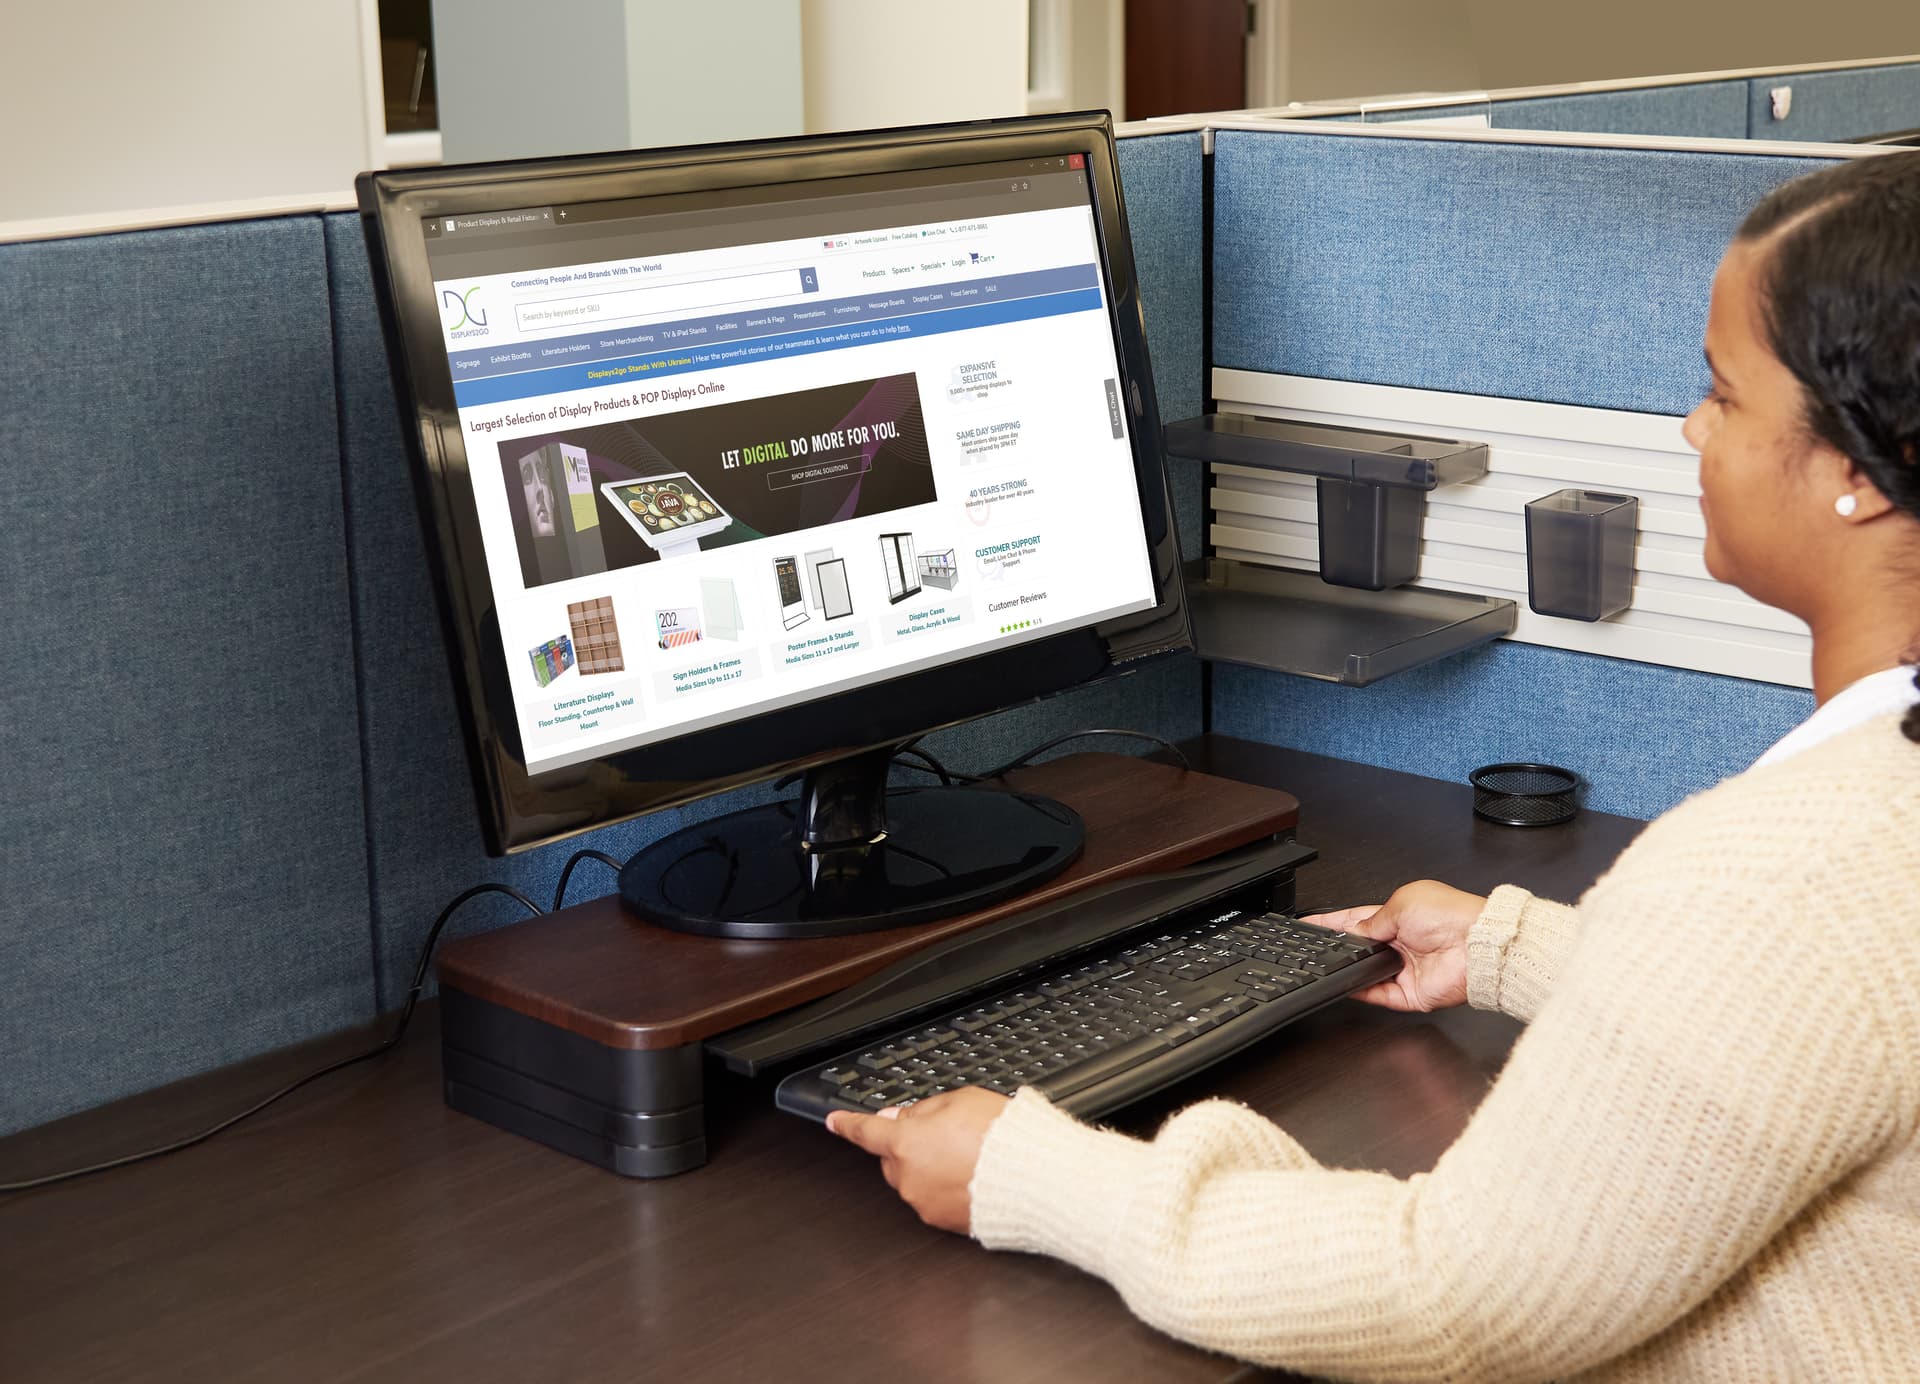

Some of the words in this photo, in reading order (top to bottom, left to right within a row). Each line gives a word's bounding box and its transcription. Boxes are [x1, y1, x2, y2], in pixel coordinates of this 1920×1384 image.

[836, 240, 844, 248] US
[951, 258, 966, 268] Login
[980, 255, 991, 263] Cart
[862, 268, 886, 278] Products
[892, 266, 911, 276] Spaces
[920, 262, 942, 271] Specials
[511, 277, 549, 288] Connecting
[550, 274, 572, 284] People
[574, 272, 587, 280] And
[588, 270, 611, 279] Brands
[612, 267, 628, 276] With
[629, 266, 641, 274] The
[642, 264, 662, 272] World
[985, 284, 997, 293] SALE
[888, 299, 905, 307] Boards
[913, 295, 929, 304] Display
[523, 311, 543, 321] Search
[544, 311, 552, 319] by
[553, 307, 578, 318] keyword
[587, 304, 600, 313] SKU
[793, 310, 826, 320] Presentations
[834, 305, 861, 314] Furnishings
[715, 322, 738, 331] Facilities
[746, 318, 766, 327] Banners
[772, 315, 785, 324] Flags
[451, 328, 489, 339] DISPLAYS2GO
[663, 331, 671, 339] TV
[689, 326, 707, 335] Stands
[600, 340, 614, 348] Store
[615, 334, 654, 346] Merchandising
[542, 345, 568, 356] Literature
[569, 343, 590, 353] Holders
[587, 366, 626, 379] Displays2go
[627, 364, 650, 373] Stands
[650, 360, 666, 369] With
[668, 357, 691, 367] Ukraine
[695, 354, 710, 363] Hear
[710, 352, 721, 361] the
[721, 348, 747, 360] powerful
[748, 345, 766, 354] stories
[767, 344, 773, 352] of
[785, 339, 815, 349] teammates
[821, 334, 835, 343] learn
[835, 333, 850, 342] what
[850, 332, 860, 341] you
[861, 330, 871, 338] can
[871, 328, 879, 336] do
[885, 326, 897, 335] help
[456, 359, 480, 369] Signage
[490, 354, 511, 364] Exhibit
[511, 351, 531, 361] Booths
[960, 360, 996, 374] EXPANSIVE
[962, 370, 998, 384] SELECTION
[469, 416, 504, 433] Largest
[506, 411, 547, 426] Selection
[548, 407, 558, 419] of
[559, 403, 592, 418] Display
[594, 398, 631, 412] Products
[632, 395, 640, 405] &
[641, 392, 660, 404] POP
[661, 387, 697, 401] Displays
[697, 380, 725, 395] Online
[956, 429, 976, 440] SAME
[976, 425, 989, 437] DAY
[990, 420, 1021, 434] SHIPPING
[721, 449, 741, 470] LET
[743, 441, 789, 465] DIGITAL
[790, 437, 808, 457] DO
[811, 430, 846, 453] MORE
[847, 424, 871, 446] FOR
[872, 420, 900, 441] YOU.
[791, 471, 804, 480] SHOP
[805, 468, 822, 478] DIGITAL
[823, 463, 849, 474] SOLUTIONS
[969, 489, 978, 498] 40
[978, 484, 1000, 497] YEARS
[1000, 478, 1028, 492] STRONG
[661, 497, 680, 509] JAVA
[975, 542, 1011, 558] CUSTOMER
[1011, 535, 1041, 550] SUPPORT
[1022, 547, 1036, 555] Phone
[1002, 559, 1021, 568] Support
[988, 597, 1020, 613] Customer
[1020, 591, 1048, 604] Reviews
[659, 612, 678, 628] 202
[909, 612, 928, 621] Display
[929, 607, 945, 616] Cases
[787, 642, 806, 652] Poster
[807, 637, 828, 647] Frames
[834, 629, 854, 640] Stands
[785, 656, 801, 664] Media
[801, 652, 815, 661] Sizes
[834, 644, 843, 652] and
[844, 641, 860, 650] Larger
[672, 670, 688, 682] Sign
[688, 665, 712, 678] Holders
[719, 658, 741, 671] Frames
[675, 683, 692, 693] Media
[693, 678, 707, 689] Sizes
[707, 676, 716, 687] Up
[716, 675, 723, 683] to
[723, 672, 730, 681] 11
[735, 670, 742, 679] 17
[553, 696, 586, 711] Literature
[587, 689, 614, 704] Displays
[538, 717, 554, 729] Floor
[582, 702, 615, 717] Countertop
[621, 697, 634, 707] Wall
[579, 720, 598, 731] Mount
